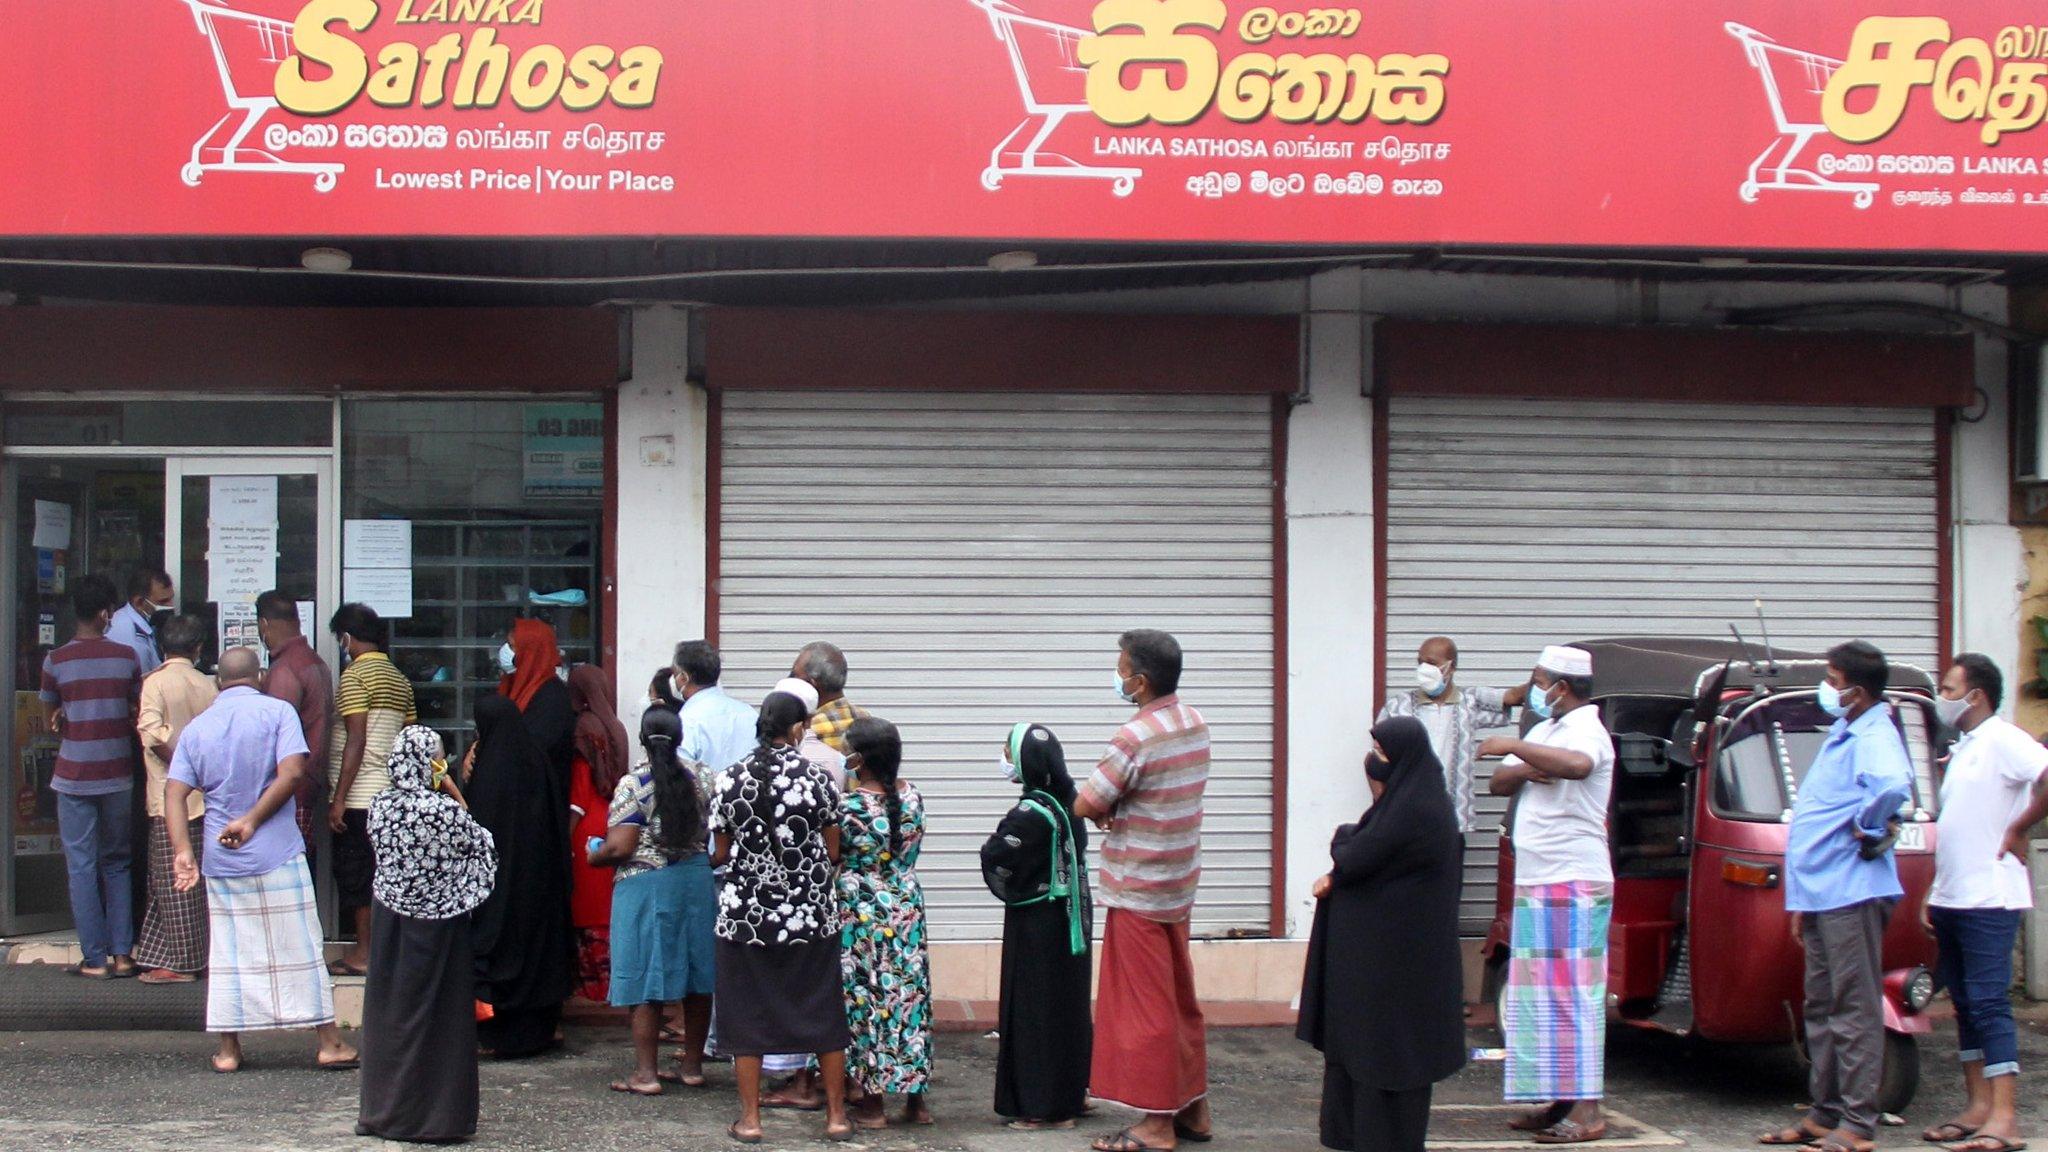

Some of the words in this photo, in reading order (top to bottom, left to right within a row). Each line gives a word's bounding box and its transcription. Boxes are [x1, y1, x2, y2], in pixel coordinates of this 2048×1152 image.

[395, 0, 543, 25] LANKA
[1239, 6, 1362, 42] ලංකා
[273, 0, 664, 115] Sathosa
[1077, 0, 1450, 126] සතොස
[264, 123, 339, 150] ලංකා
[344, 124, 448, 148] සතොස
[455, 122, 551, 149] லங்கா
[562, 123, 666, 158] சதொச
[1094, 137, 1166, 156] LANKA
[1170, 138, 1269, 157] SATHOSA
[1274, 134, 1355, 159] லங்கா
[1364, 136, 1451, 165] சதொச
[1817, 153, 1874, 175] ලංකා
[1877, 155, 1955, 173] සතොස
[1963, 156, 2039, 174] LANKA
[376, 167, 463, 189] Lowest
[608, 170, 675, 191] Place
[1250, 169, 1306, 196] මිලට
